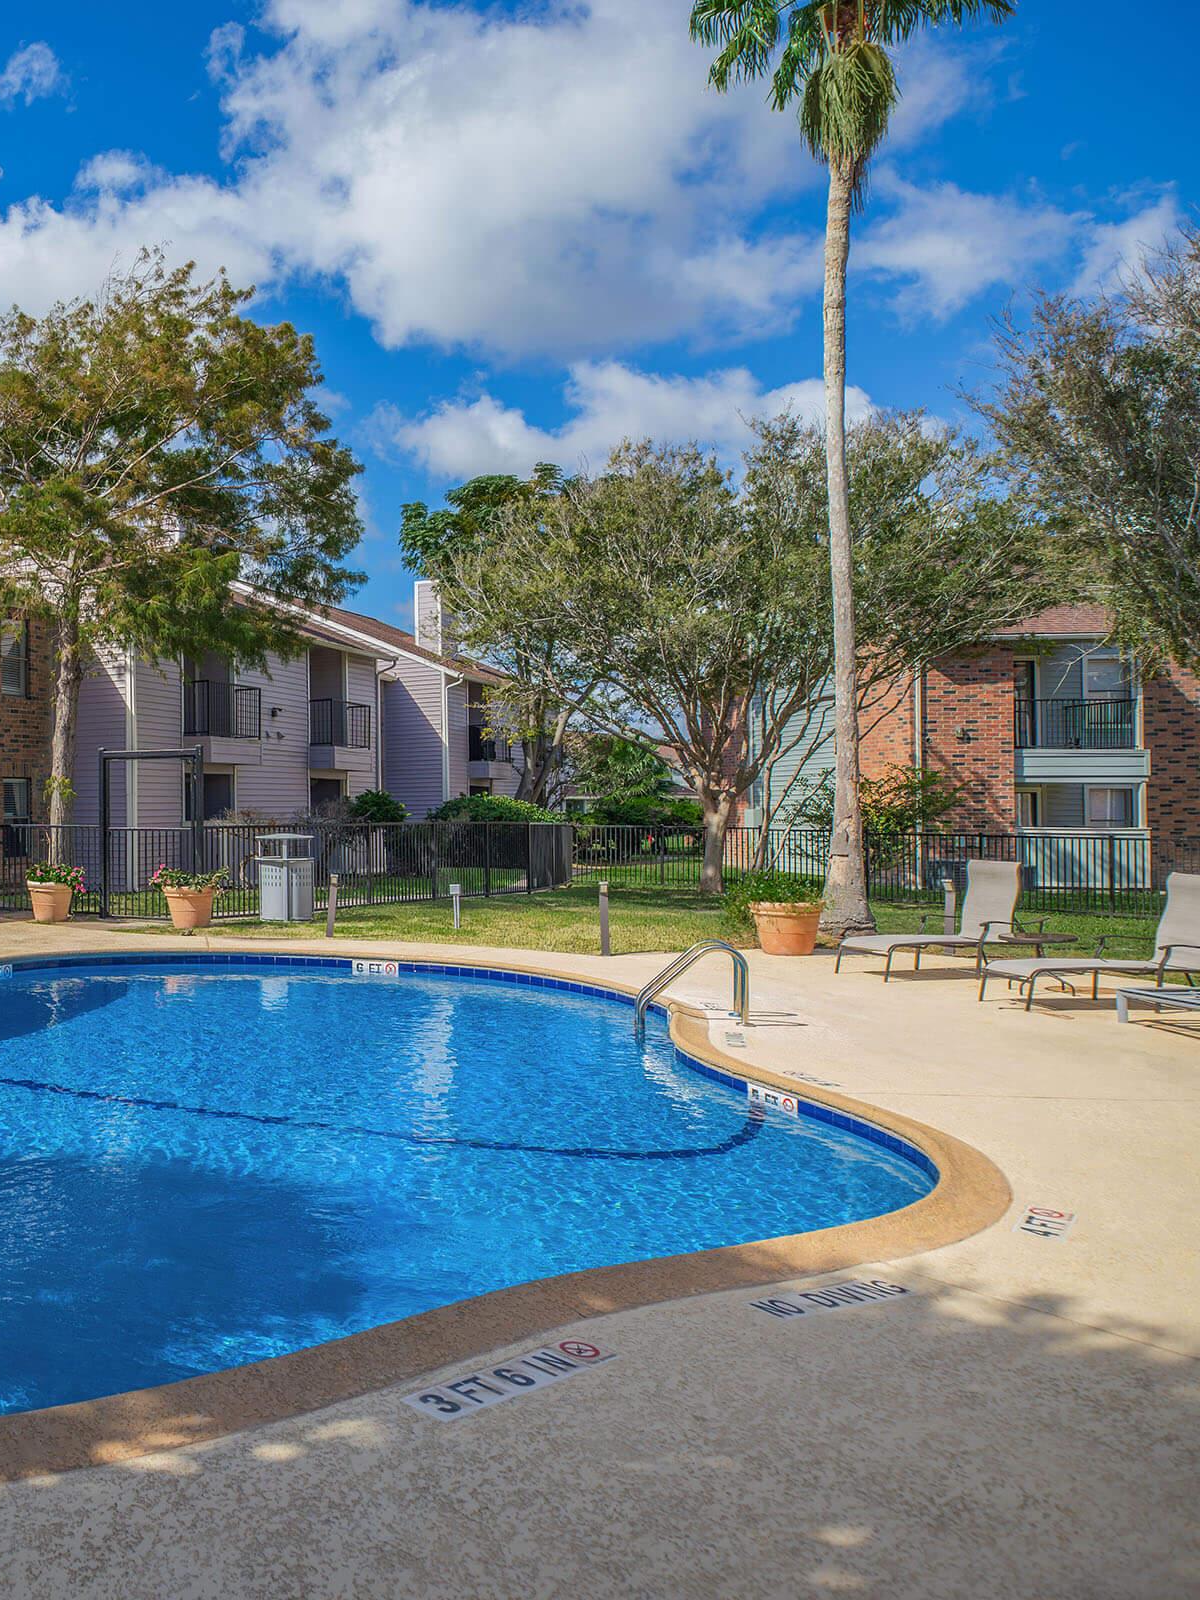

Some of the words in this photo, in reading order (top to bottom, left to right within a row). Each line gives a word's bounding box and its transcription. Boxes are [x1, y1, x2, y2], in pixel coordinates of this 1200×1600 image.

[1025, 1215, 1065, 1231] FT
[749, 1299, 805, 1319] NO
[798, 1279, 910, 1309] DIVING
[418, 1393, 462, 1413] 3
[447, 1376, 504, 1404] FT
[492, 1368, 536, 1387] 6
[521, 1351, 578, 1377] IN
